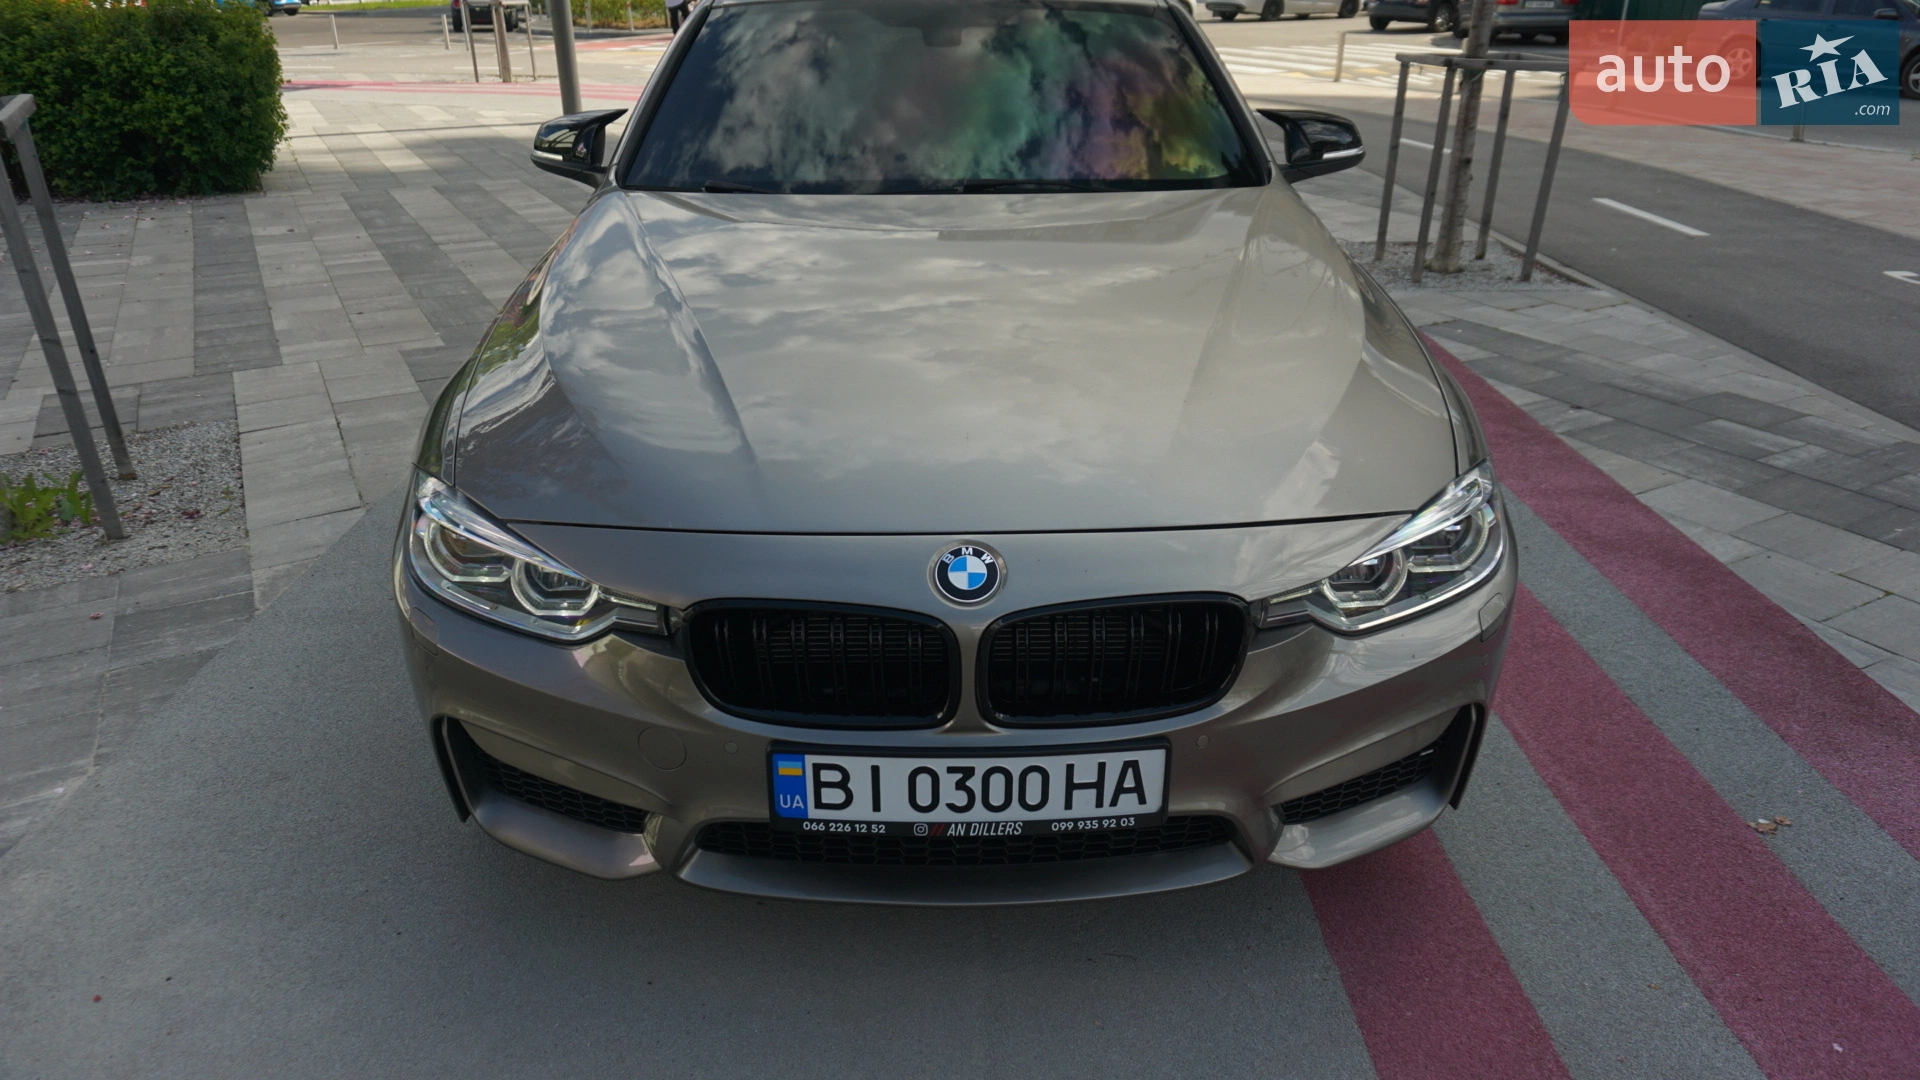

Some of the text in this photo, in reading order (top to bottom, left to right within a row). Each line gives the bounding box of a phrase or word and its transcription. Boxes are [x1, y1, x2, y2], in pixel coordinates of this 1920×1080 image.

[942, 547, 994, 564] BMW
[812, 759, 1148, 814] BI 0300 HA
[779, 794, 805, 809] UA
[803, 821, 887, 834] 066 226 12 52
[947, 821, 1023, 836] AN DILLERS
[1051, 817, 1135, 831] 099 935 92 03
